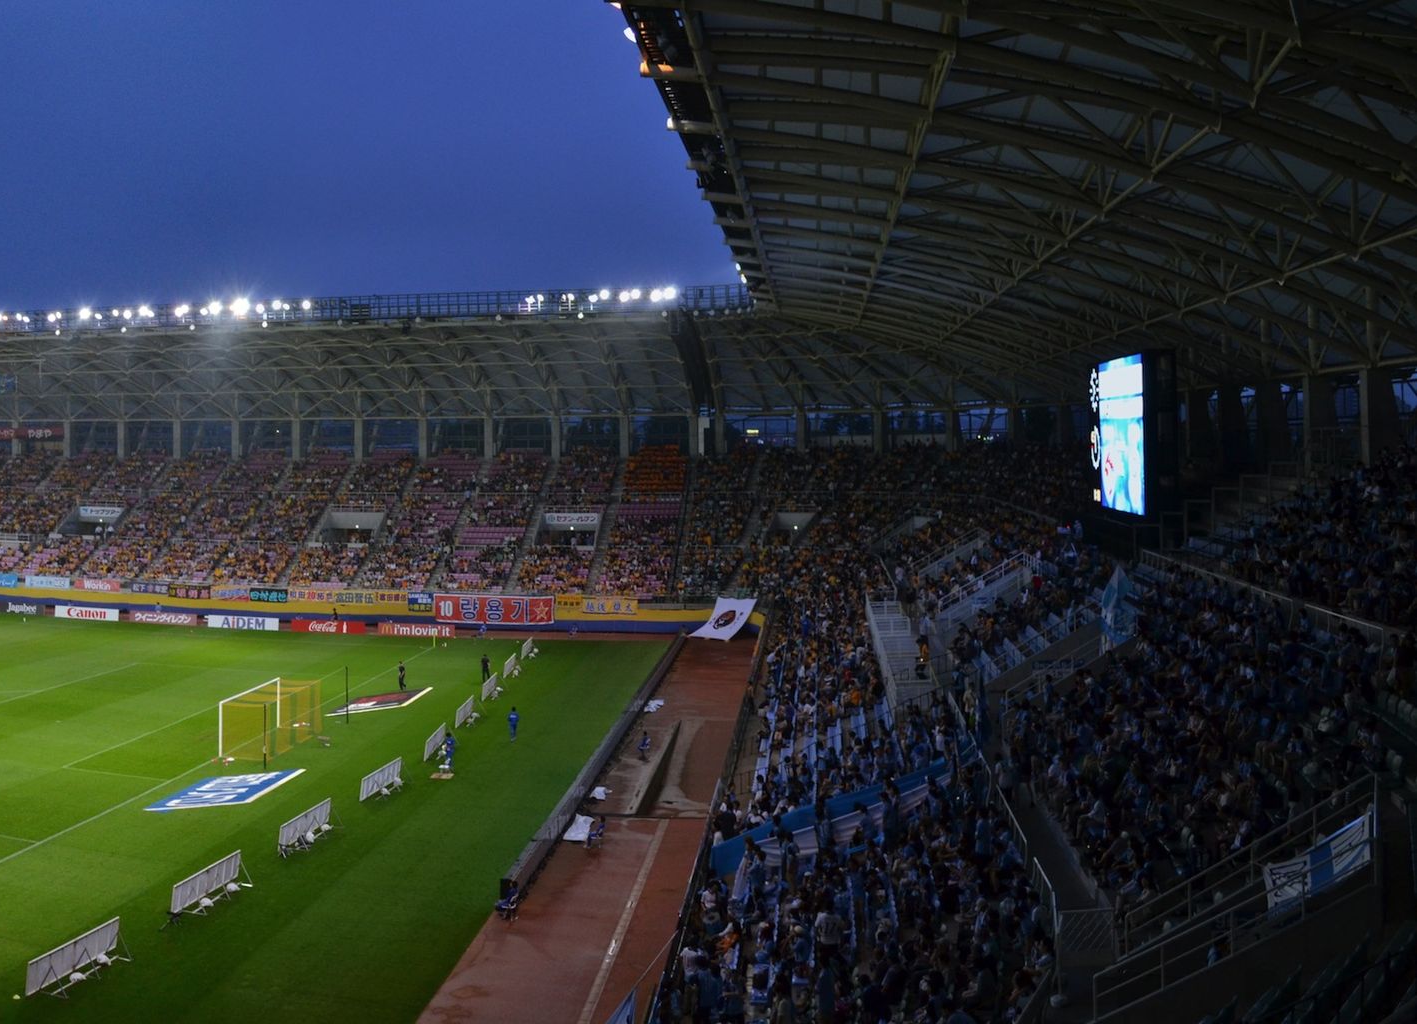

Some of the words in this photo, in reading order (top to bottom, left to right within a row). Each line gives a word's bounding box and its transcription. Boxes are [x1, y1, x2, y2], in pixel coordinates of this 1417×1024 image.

[67, 607, 107, 619] Canon
[439, 600, 454, 617] 10
[459, 597, 530, 622] 량용기
[441, 626, 451, 636] it
